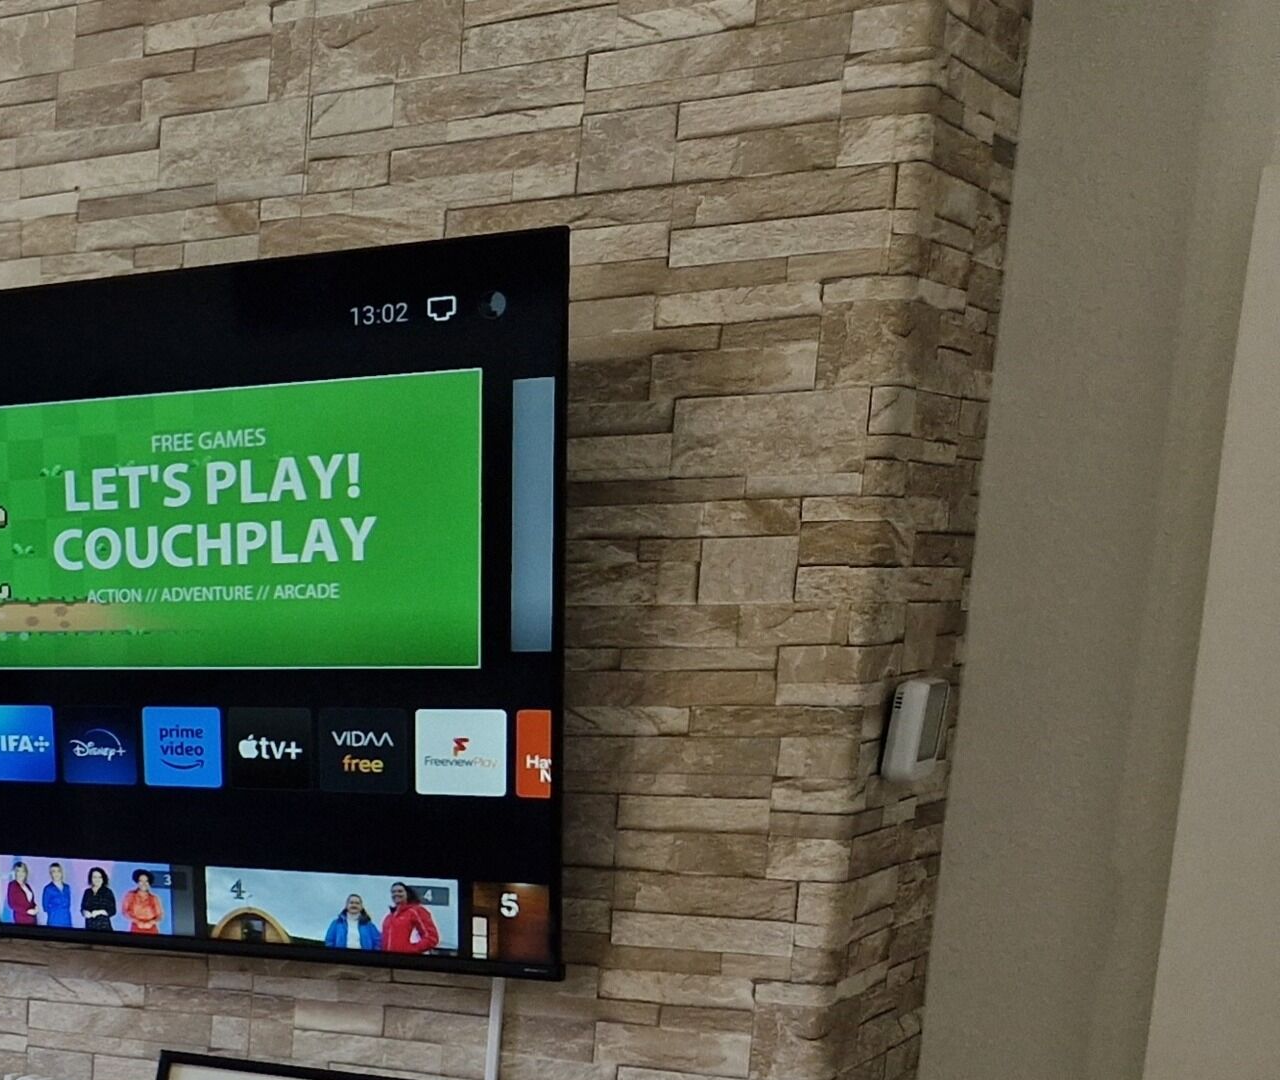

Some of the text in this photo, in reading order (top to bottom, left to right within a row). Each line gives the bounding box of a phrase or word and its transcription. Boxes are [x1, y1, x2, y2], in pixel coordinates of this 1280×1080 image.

[349, 302, 409, 326] 13:02
[151, 428, 266, 453] FREE GAMES
[64, 452, 361, 512] LET'S PLAY!
[53, 516, 377, 571] COUCHPLAY
[87, 588, 142, 604] ACTION
[160, 585, 254, 603] ADVENTURE
[274, 583, 340, 600] ARCADE
[159, 724, 204, 741] prime
[160, 742, 204, 757] video
[259, 736, 303, 760] tv+
[342, 754, 384, 773] free
[163, 874, 171, 886] 3
[425, 889, 434, 902] 4
[500, 892, 520, 918] 5
